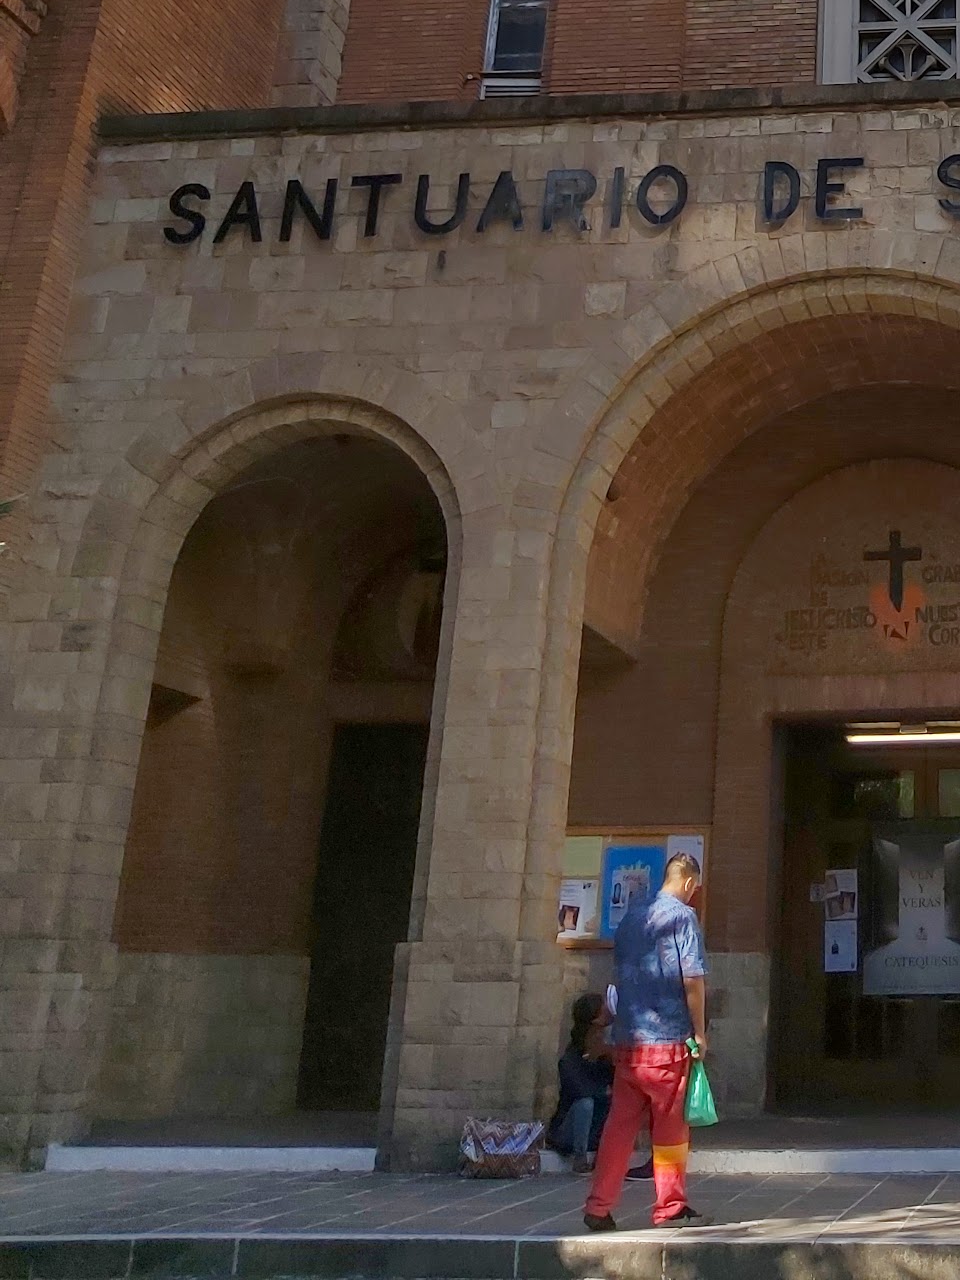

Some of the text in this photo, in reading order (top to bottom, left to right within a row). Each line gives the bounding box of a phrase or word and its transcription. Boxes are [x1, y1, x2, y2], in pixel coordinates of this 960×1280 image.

[164, 164, 690, 244] SANTUARIO
[764, 157, 865, 221] DE
[909, 869, 934, 880] VEN
[917, 883, 925, 894] Y
[884, 956, 960, 970] CATEQUESIS
